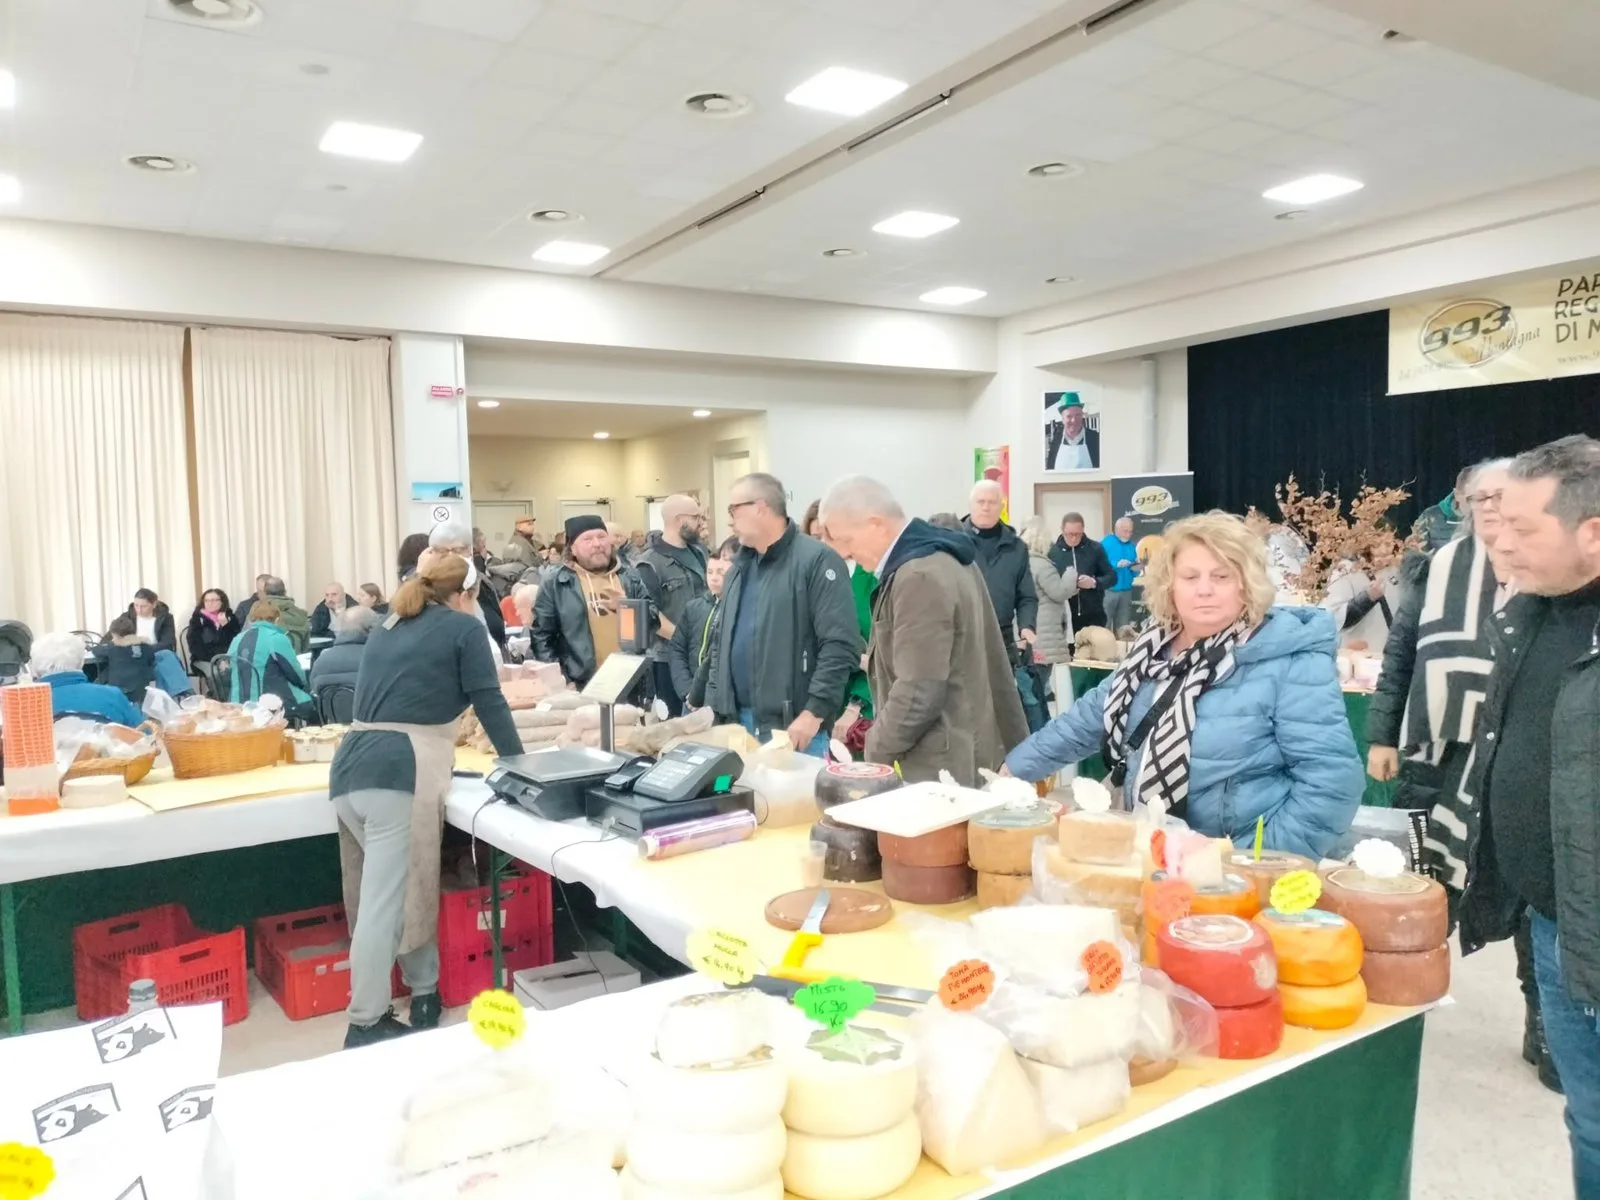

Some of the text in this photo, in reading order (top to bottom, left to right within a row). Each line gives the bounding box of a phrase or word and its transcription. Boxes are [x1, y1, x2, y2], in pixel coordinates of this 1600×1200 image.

[1422, 306, 1511, 355] 993
[1556, 321, 1578, 343] DI
[1135, 492, 1168, 507] 993
